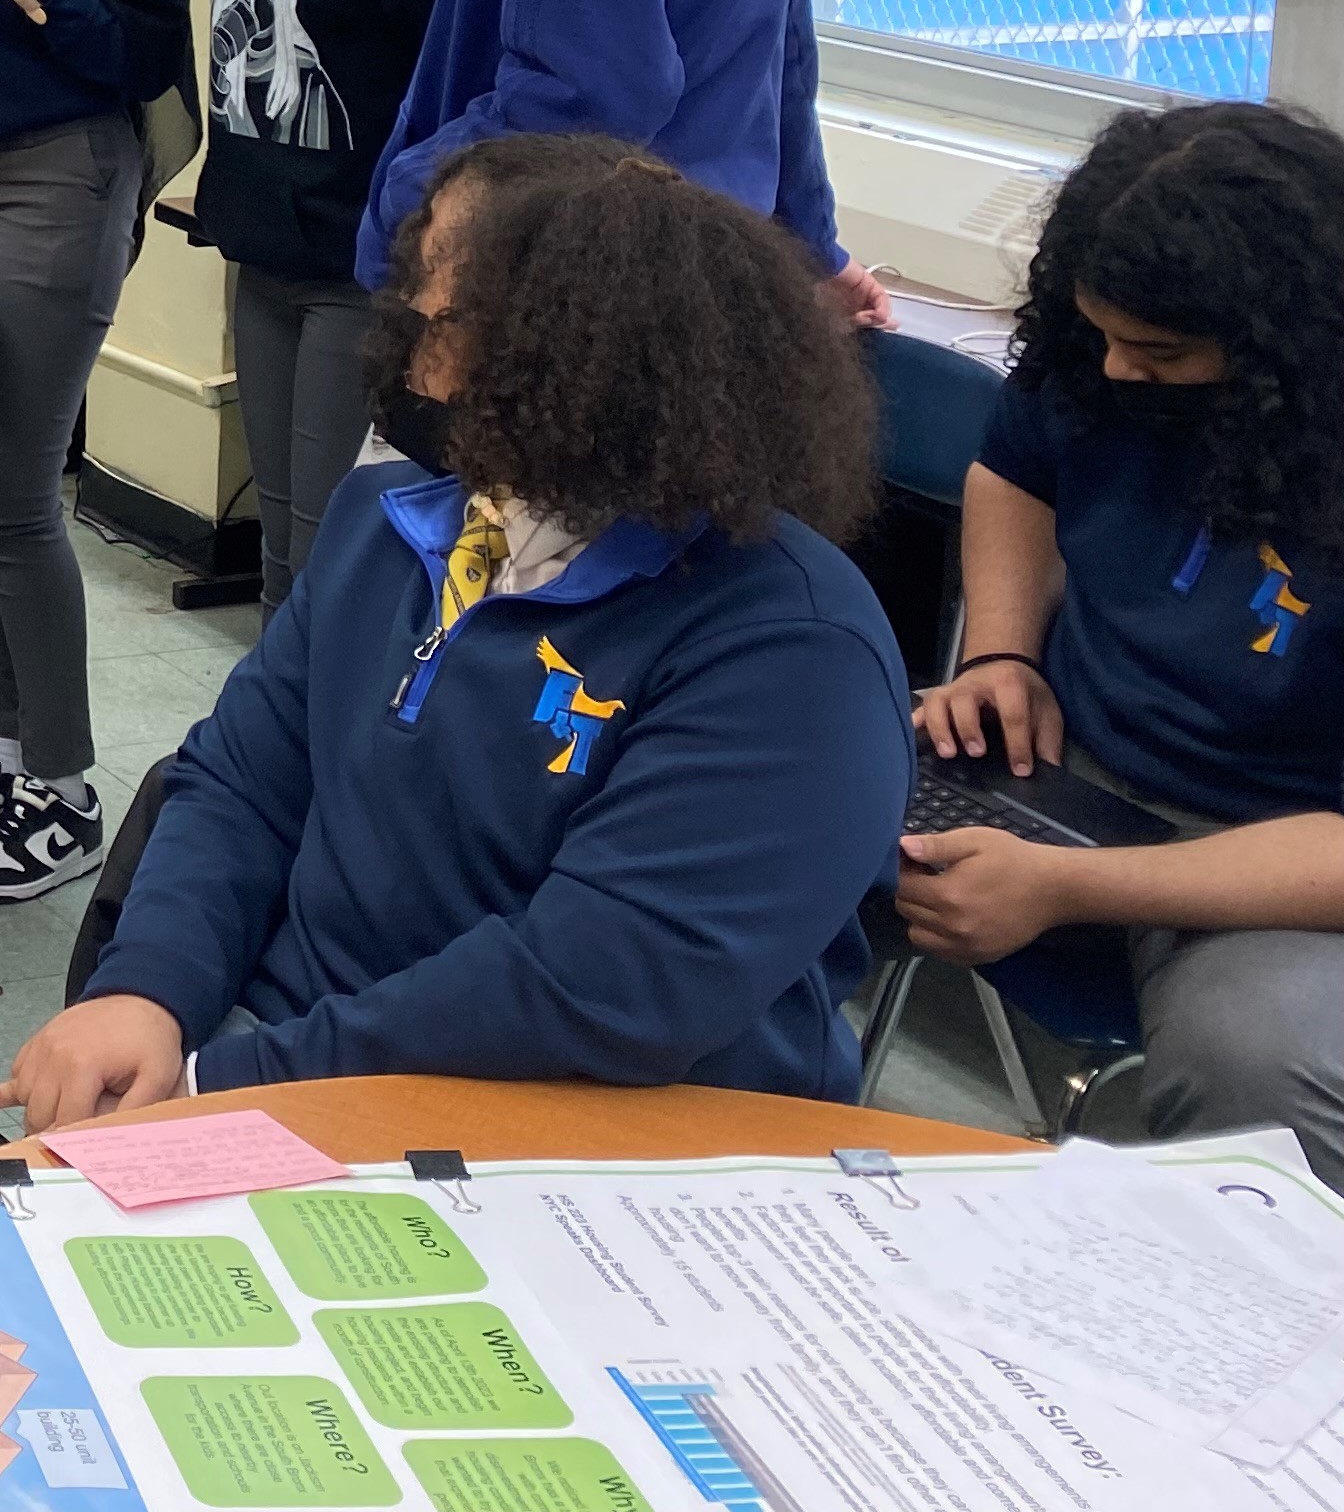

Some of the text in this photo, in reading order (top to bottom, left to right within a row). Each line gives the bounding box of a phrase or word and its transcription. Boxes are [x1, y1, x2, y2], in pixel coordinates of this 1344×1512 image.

[402, 1216, 450, 1259] Who?
[539, 1194, 625, 1293] NYC Speaks Dashboard
[616, 1195, 724, 1312] Approximately 15 students
[647, 1207, 685, 1243] housing
[226, 1267, 273, 1314] How?
[557, 1194, 670, 1328] HS 223 Housing Student Survey
[482, 1328, 543, 1396] When?
[827, 1191, 893, 1242] Result
[1038, 1404, 1123, 1479] Survey:
[37, 1411, 64, 1452] building
[61, 1411, 96, 1464] 25-50 unit
[305, 1399, 369, 1475] Where?
[599, 1476, 636, 1512] Wh
